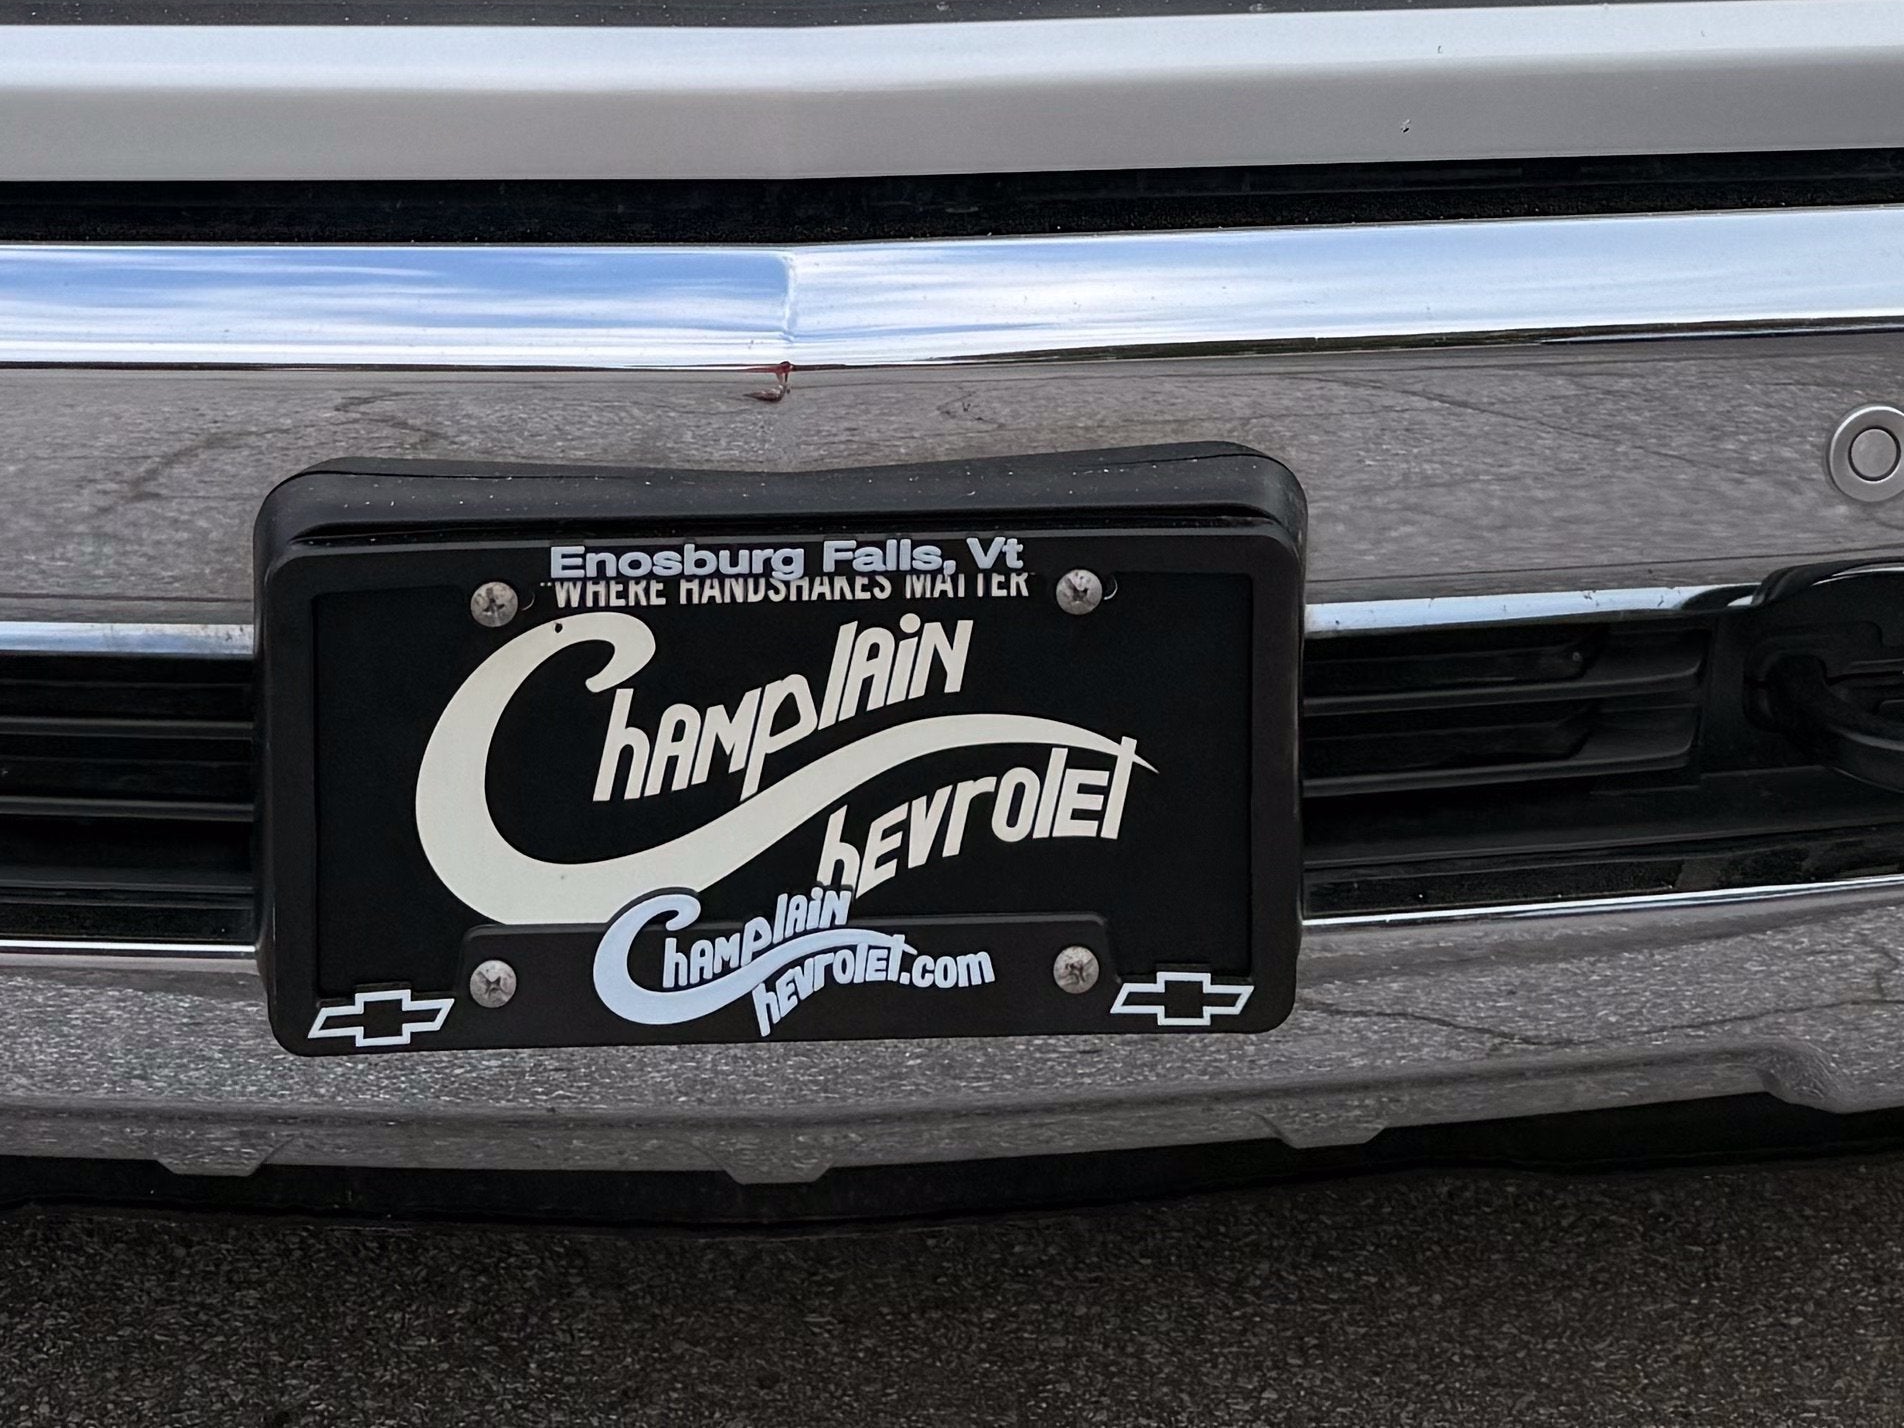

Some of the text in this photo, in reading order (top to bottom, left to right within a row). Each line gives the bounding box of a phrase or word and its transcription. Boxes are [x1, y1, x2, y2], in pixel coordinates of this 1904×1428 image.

[550, 536, 1025, 581] Enosburg Falls, Vt
[679, 574, 892, 604] HANDSHAKES
